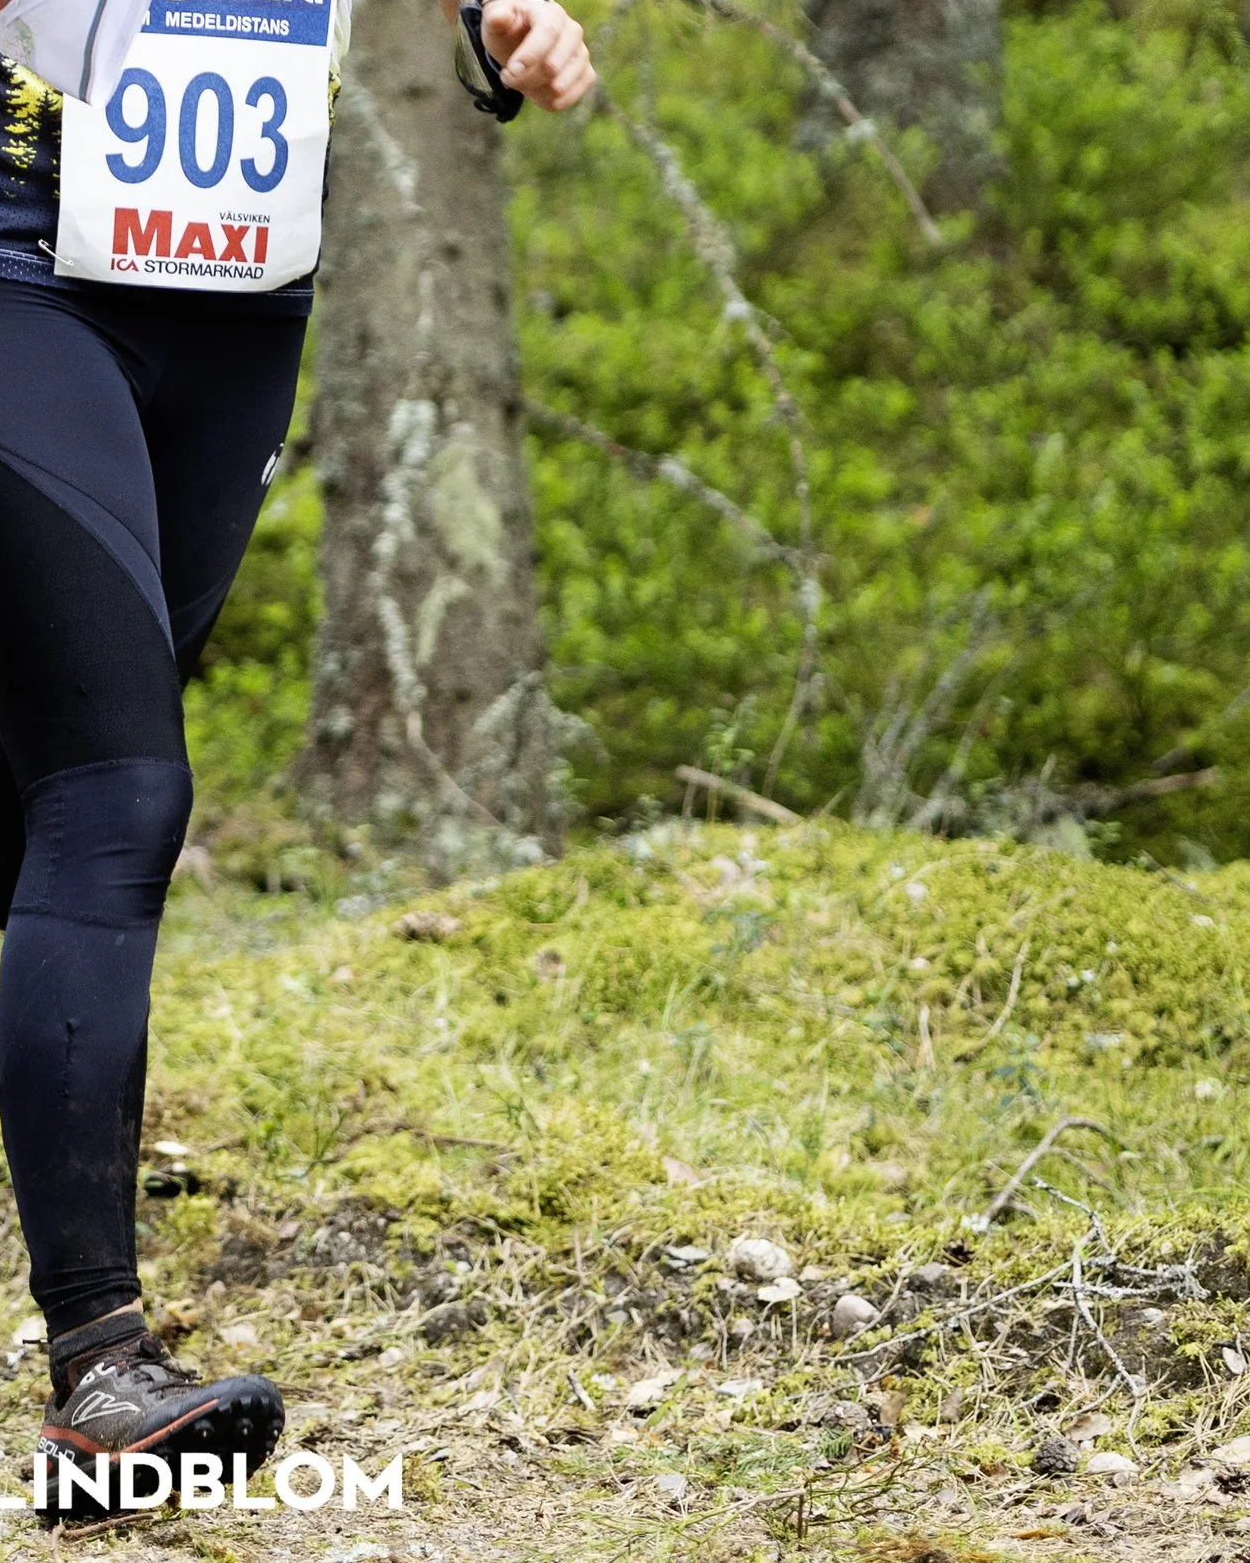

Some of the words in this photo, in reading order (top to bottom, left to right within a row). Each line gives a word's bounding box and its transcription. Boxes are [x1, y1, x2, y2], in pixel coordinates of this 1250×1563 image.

[165, 11, 290, 36] MEDELDISTANS
[105, 67, 289, 193] 903
[219, 211, 271, 224] VÄLSVIKEN
[112, 207, 270, 264] MAXI
[110, 258, 140, 272] ICA
[144, 259, 265, 280] STORMARKNAD
